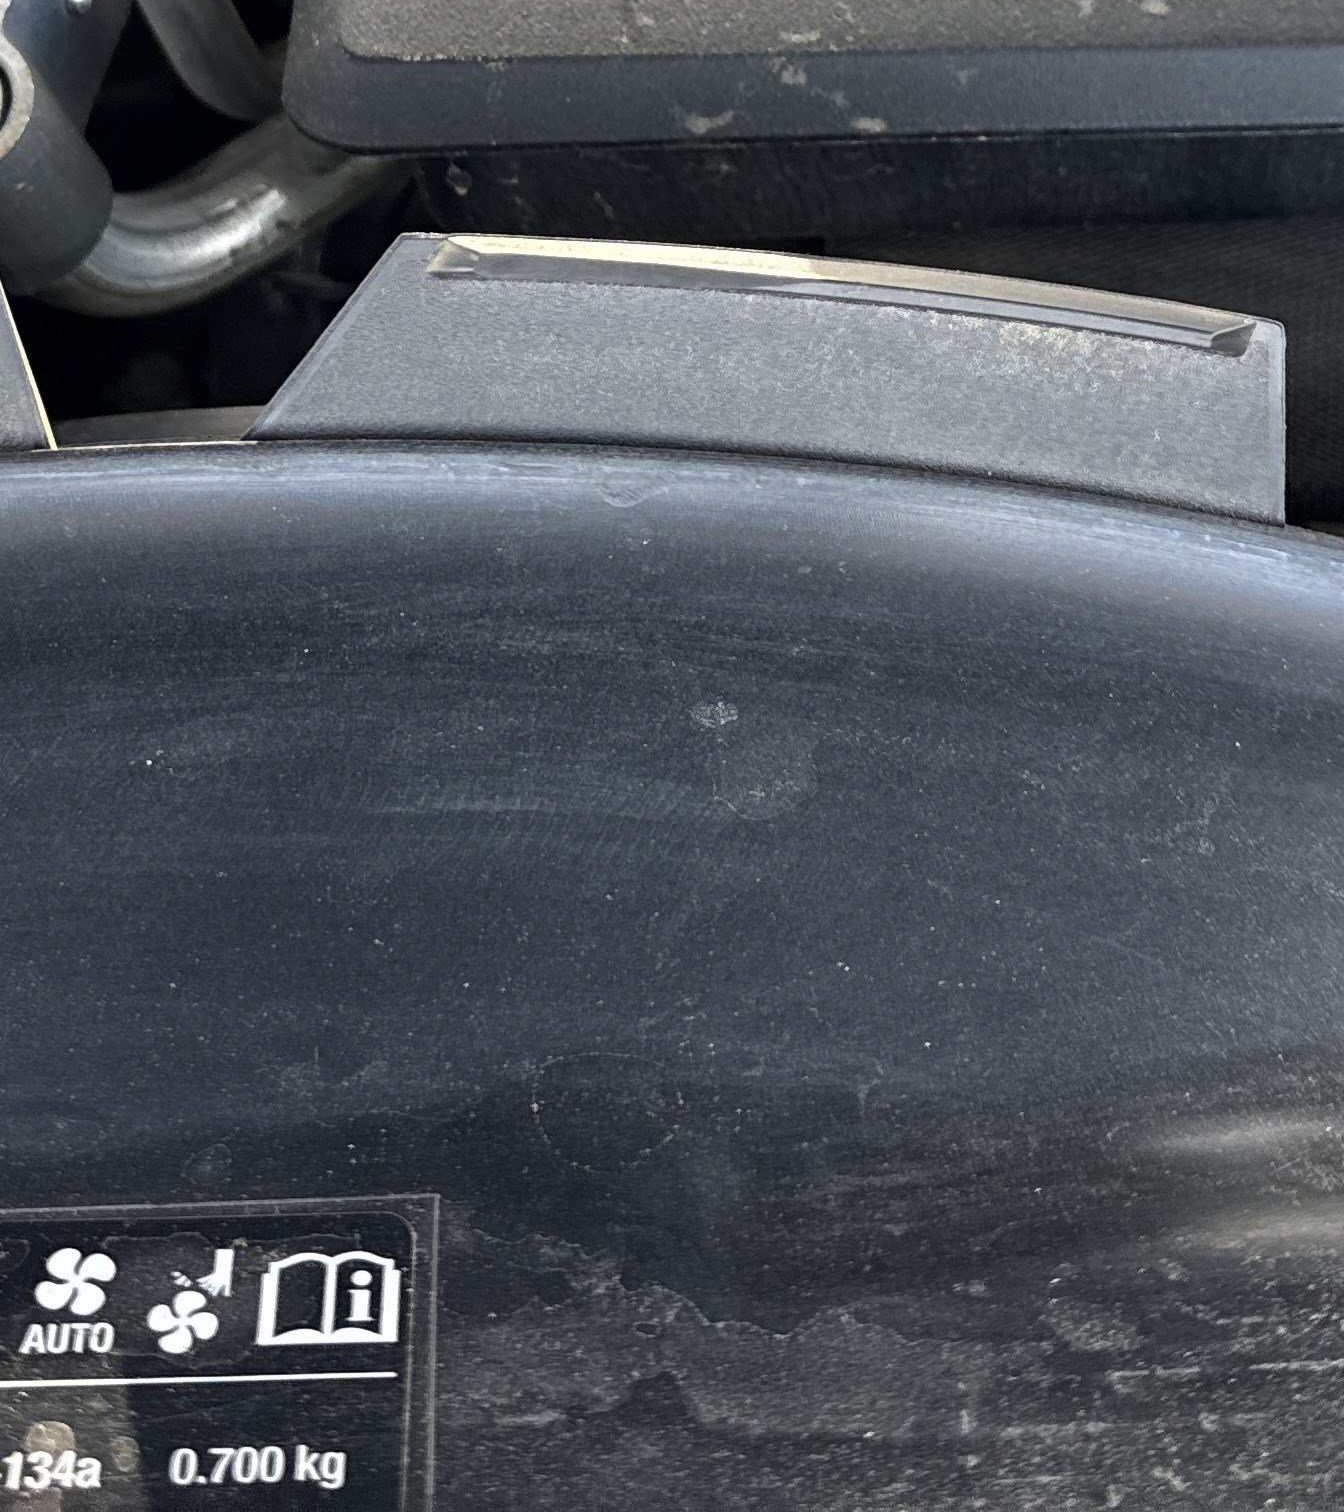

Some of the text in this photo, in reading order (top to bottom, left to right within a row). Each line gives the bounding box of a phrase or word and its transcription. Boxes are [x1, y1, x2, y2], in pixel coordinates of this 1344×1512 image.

[20, 1322, 116, 1356] AUTO
[169, 1444, 347, 1490] 0.700 kg
